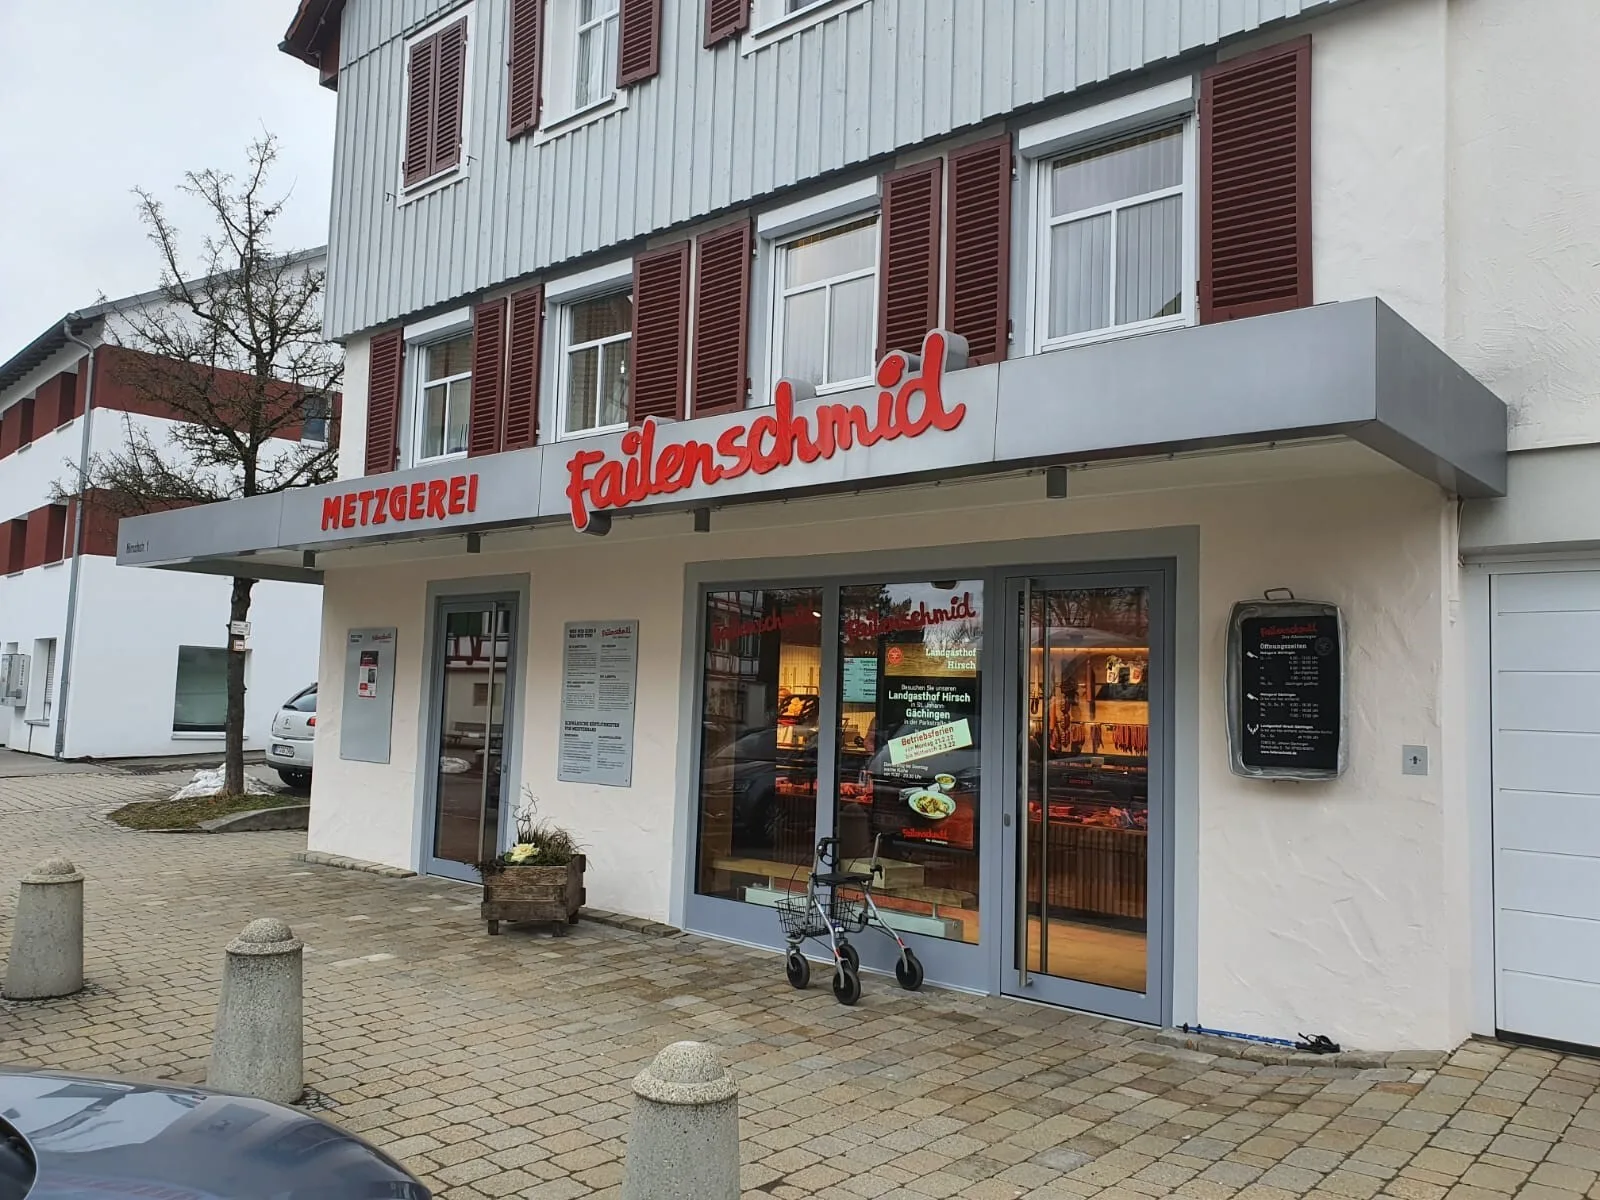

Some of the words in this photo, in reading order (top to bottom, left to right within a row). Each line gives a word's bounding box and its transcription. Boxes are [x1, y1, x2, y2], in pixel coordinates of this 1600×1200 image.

[566, 333, 966, 530] Failenschmid
[321, 474, 479, 531] METZGEREI
[1259, 641, 1308, 650] Öffnungszeiten
[925, 647, 977, 658] Landgasthof
[947, 660, 976, 670] Hirsch
[888, 690, 941, 702] Landgasthof
[942, 692, 971, 702] Hirsch
[905, 708, 951, 721] Gächingen
[901, 726, 954, 747] Betriebsferien
[914, 741, 934, 750] Montag
